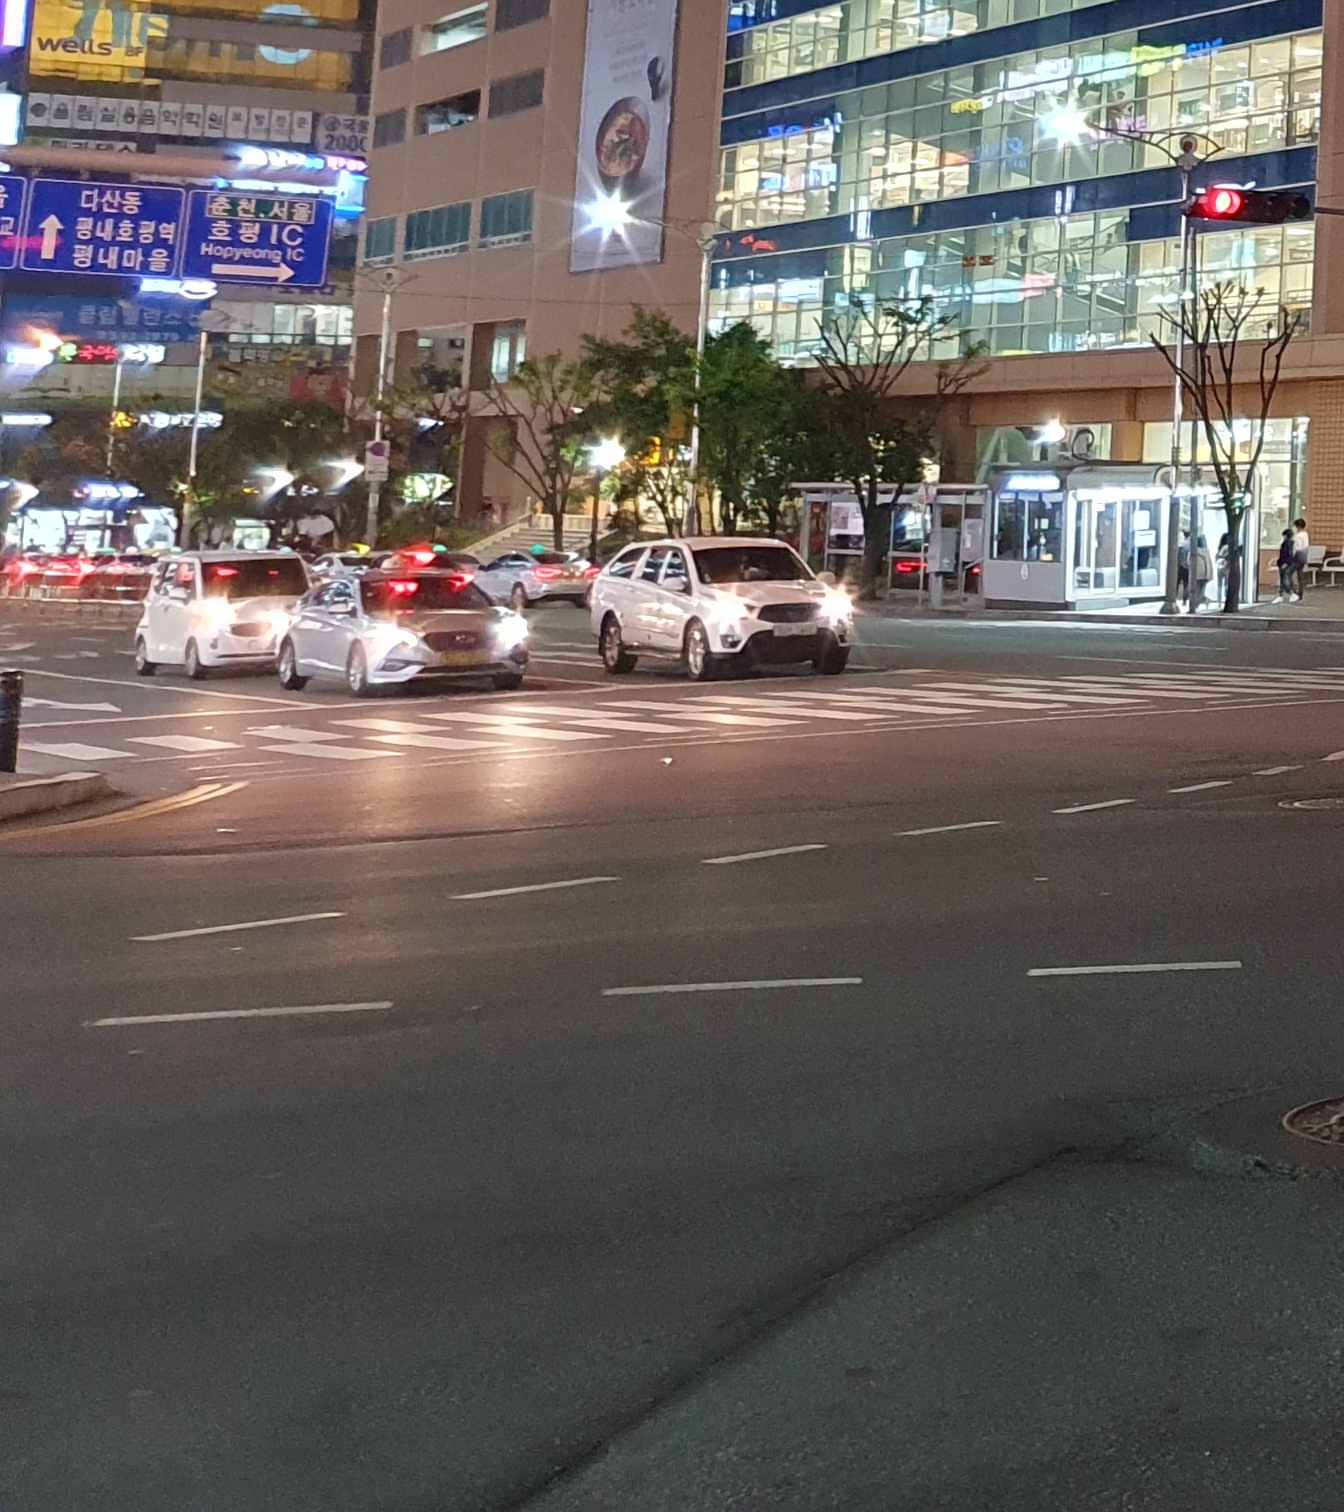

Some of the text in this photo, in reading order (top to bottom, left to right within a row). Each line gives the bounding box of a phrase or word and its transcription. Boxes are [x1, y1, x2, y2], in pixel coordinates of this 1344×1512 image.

[37, 37, 112, 56] wells
[80, 188, 143, 215] 다산동
[75, 217, 176, 245] 평내호평역
[207, 220, 304, 246] 호평 IC
[73, 244, 170, 272] 평내마을
[200, 243, 304, 263] Hopyeong IC
